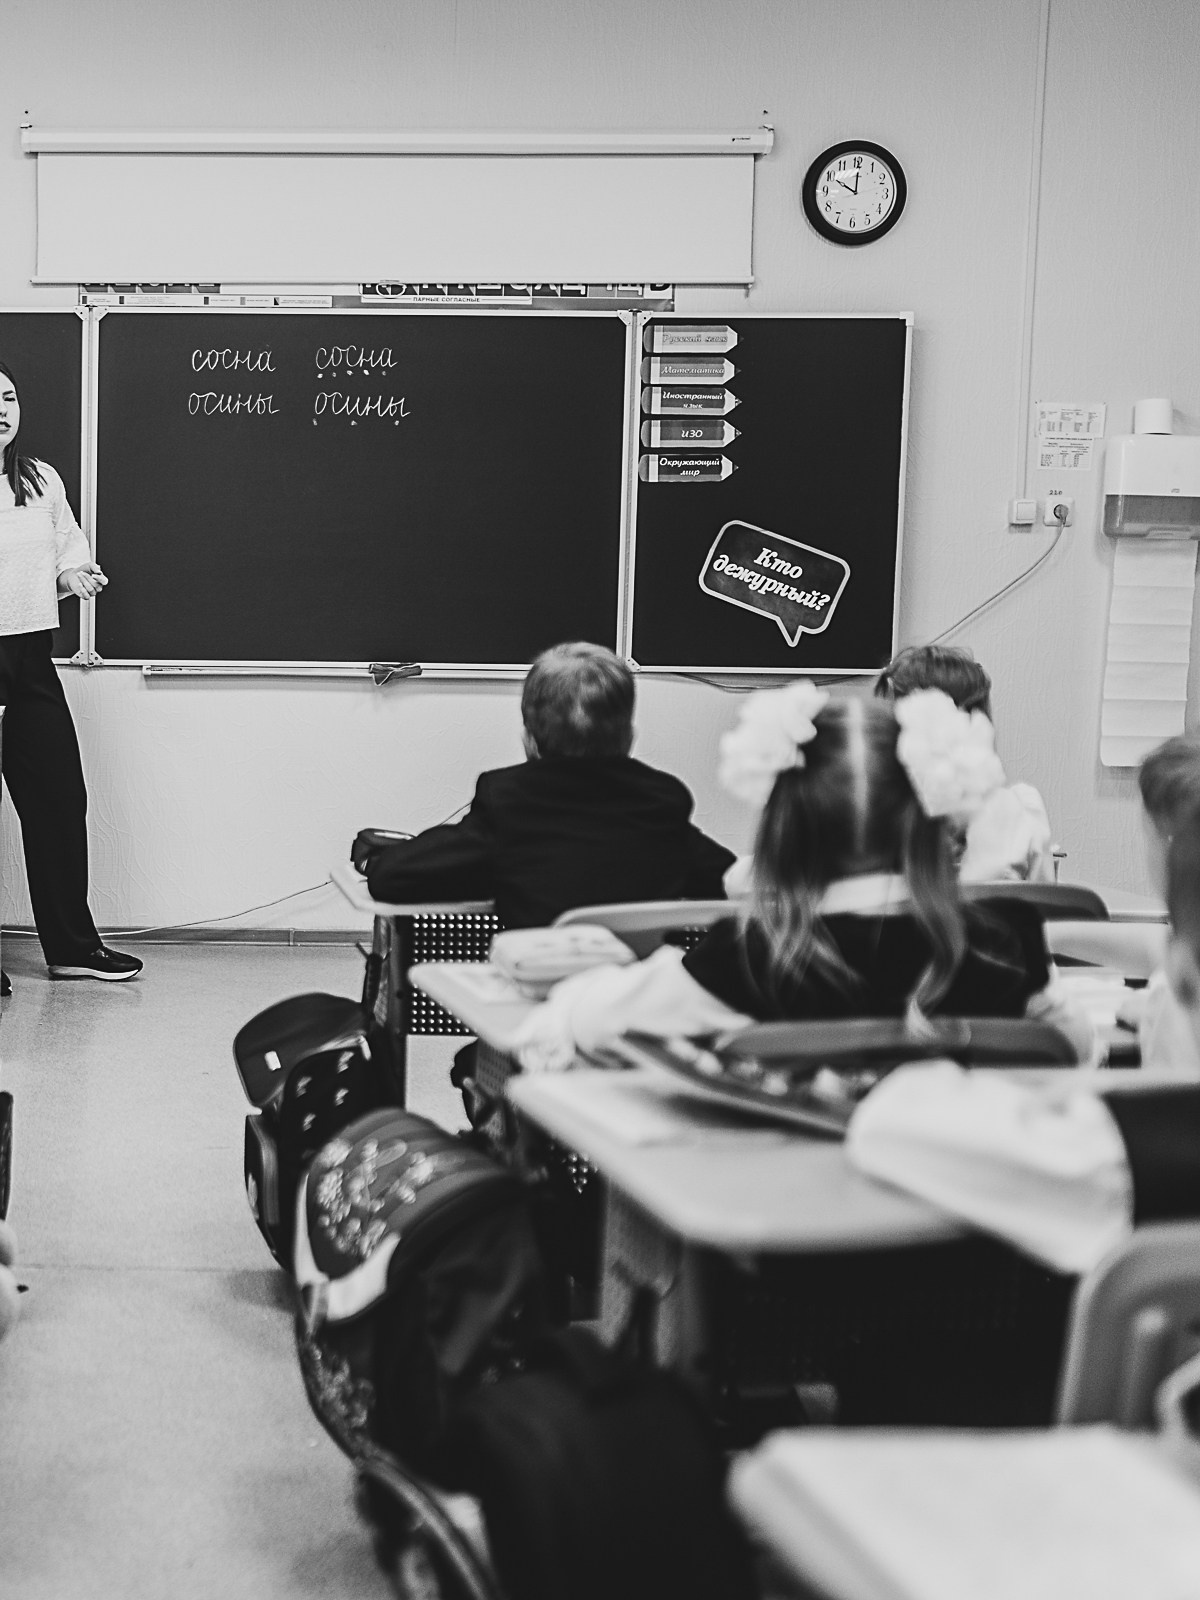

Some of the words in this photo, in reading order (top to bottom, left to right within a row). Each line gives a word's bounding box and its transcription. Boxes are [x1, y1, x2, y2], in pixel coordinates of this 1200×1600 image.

[838, 160, 846, 171] 11
[853, 156, 863, 169] 12
[871, 162, 875, 173] 1
[826, 170, 835, 182] 10
[879, 173, 886, 185] 2
[822, 185, 829, 197] 9
[882, 188, 889, 200] 3
[825, 200, 832, 212] 8
[876, 203, 882, 215] 4
[836, 211, 841, 224] 7
[849, 216, 856, 228] 6
[864, 214, 871, 226] 5
[191, 348, 277, 372] сосна
[315, 345, 398, 370] сосна
[661, 366, 725, 375] Математика
[662, 390, 723, 401] Иностранный
[188, 392, 281, 416] осины
[314, 392, 411, 417] осины
[681, 430, 703, 438] ИЗО
[660, 457, 720, 467] Окружающий
[753, 547, 803, 579] Кто
[712, 554, 831, 611] дежурный?
